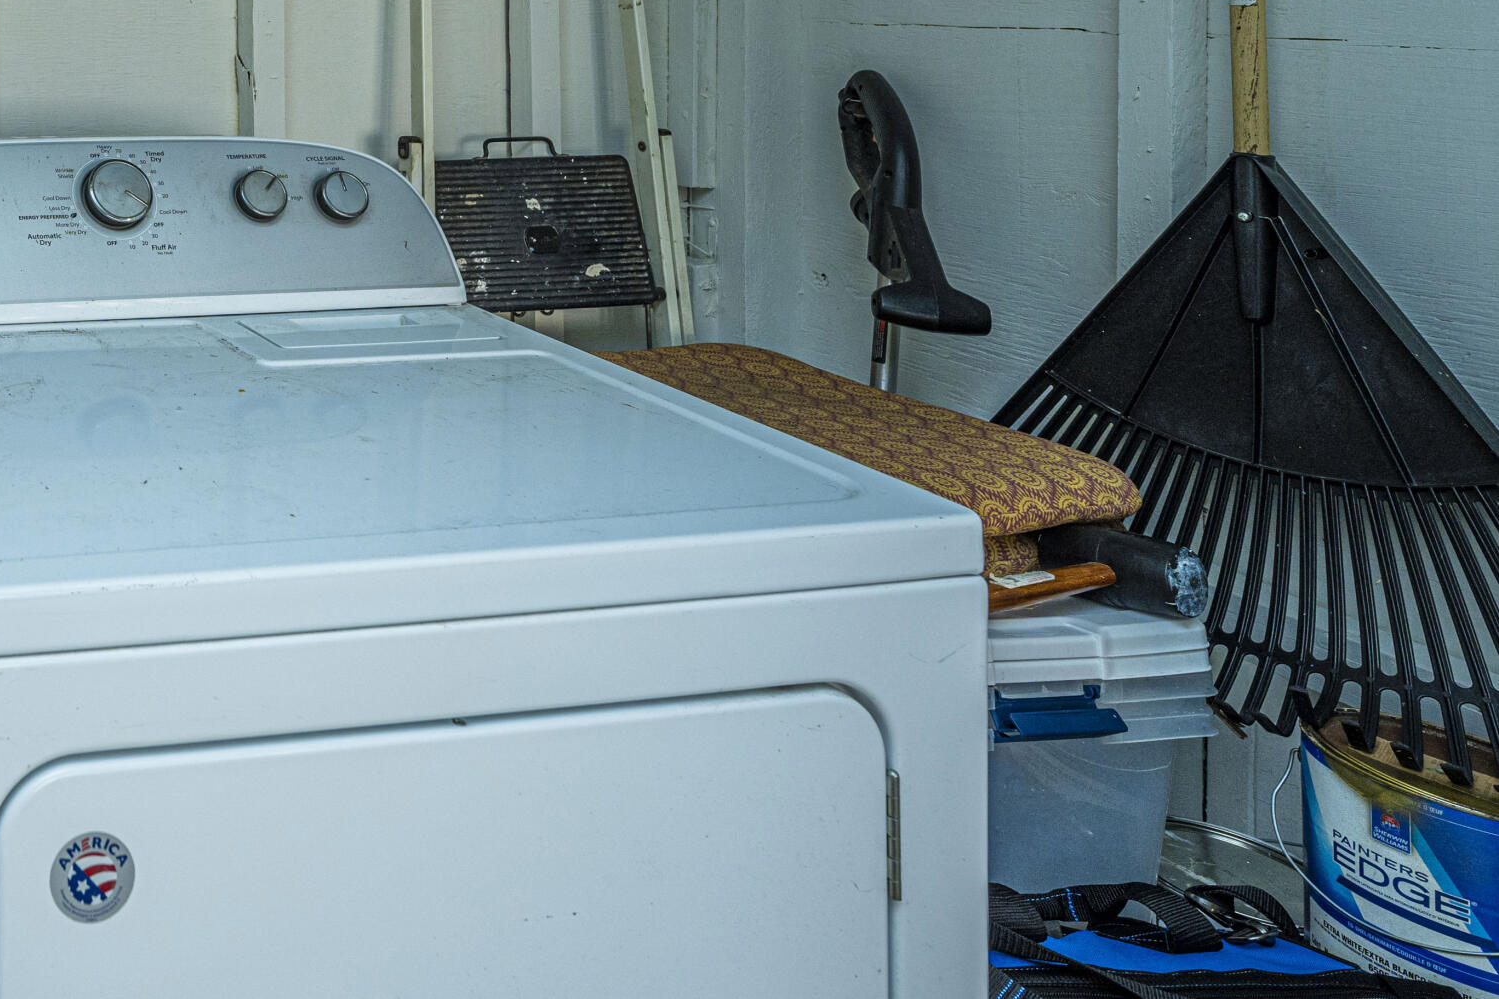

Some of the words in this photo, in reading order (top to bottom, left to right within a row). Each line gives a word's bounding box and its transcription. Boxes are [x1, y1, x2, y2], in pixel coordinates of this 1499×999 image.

[59, 836, 129, 871] AMERICA
[1332, 828, 1429, 883] PAINTERS
[1373, 825, 1409, 845] SHERWIN
[1373, 831, 1410, 852] WILLIAMS
[1332, 840, 1471, 924] EDGE
[1323, 919, 1341, 938] EXTRA
[1341, 932, 1390, 968] WHITE/EXTRA
